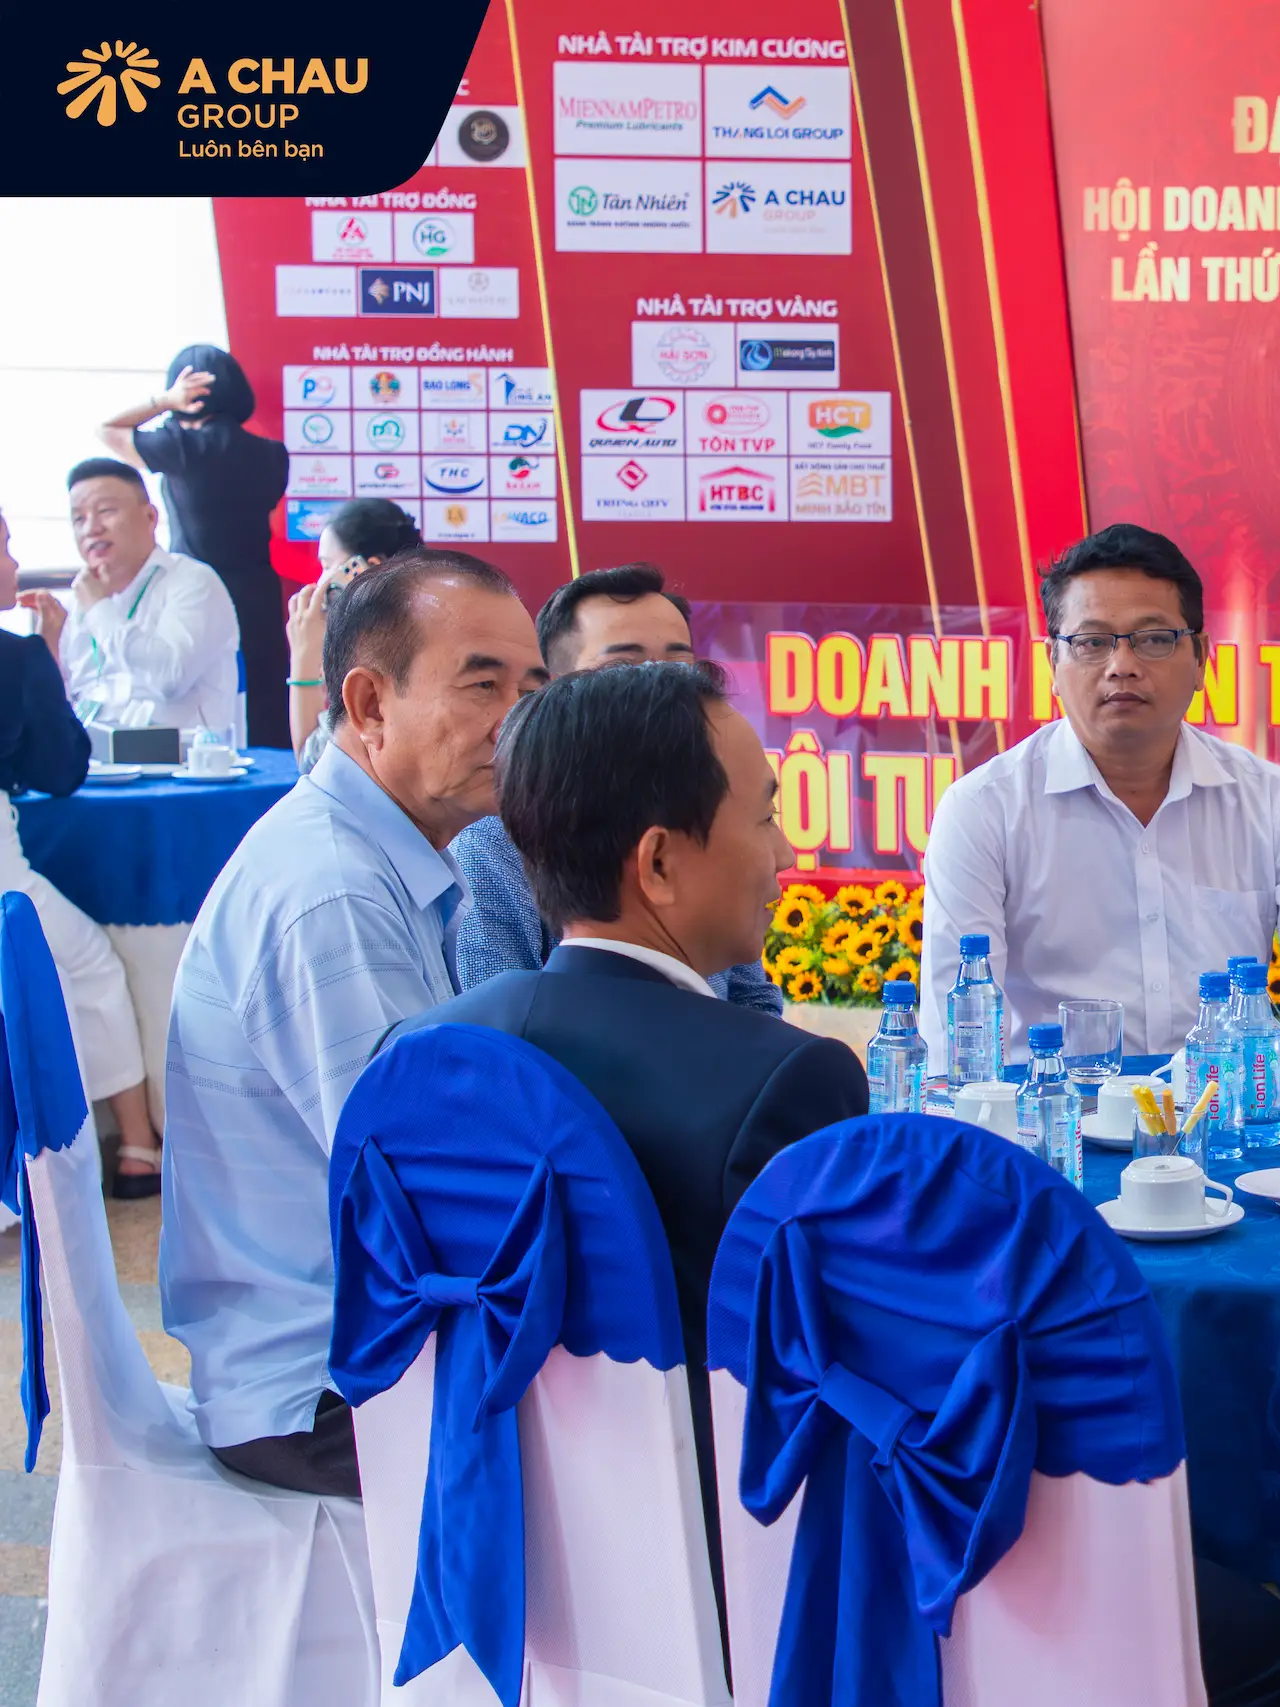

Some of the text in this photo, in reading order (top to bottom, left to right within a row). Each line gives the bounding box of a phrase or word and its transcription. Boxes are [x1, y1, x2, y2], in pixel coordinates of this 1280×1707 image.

[558, 31, 612, 55] NHÀ
[615, 31, 652, 56] TÀI
[657, 37, 708, 60] TRỢ
[712, 39, 757, 57] KIM
[792, 128, 843, 140] GROUP
[764, 190, 846, 206] A CHAU
[1083, 177, 1151, 242] HỘI
[1111, 241, 1190, 302] LẦN
[393, 281, 430, 307] PNJ
[637, 293, 838, 319] NHÀ TÀI TRỢ VÀNG
[815, 406, 865, 425] HCT
[699, 435, 775, 453] TÔN TVP
[710, 485, 764, 501] HTBC
[826, 475, 886, 497] MBT
[767, 632, 1010, 721] DOANH
[1252, 1053, 1266, 1080] Life
